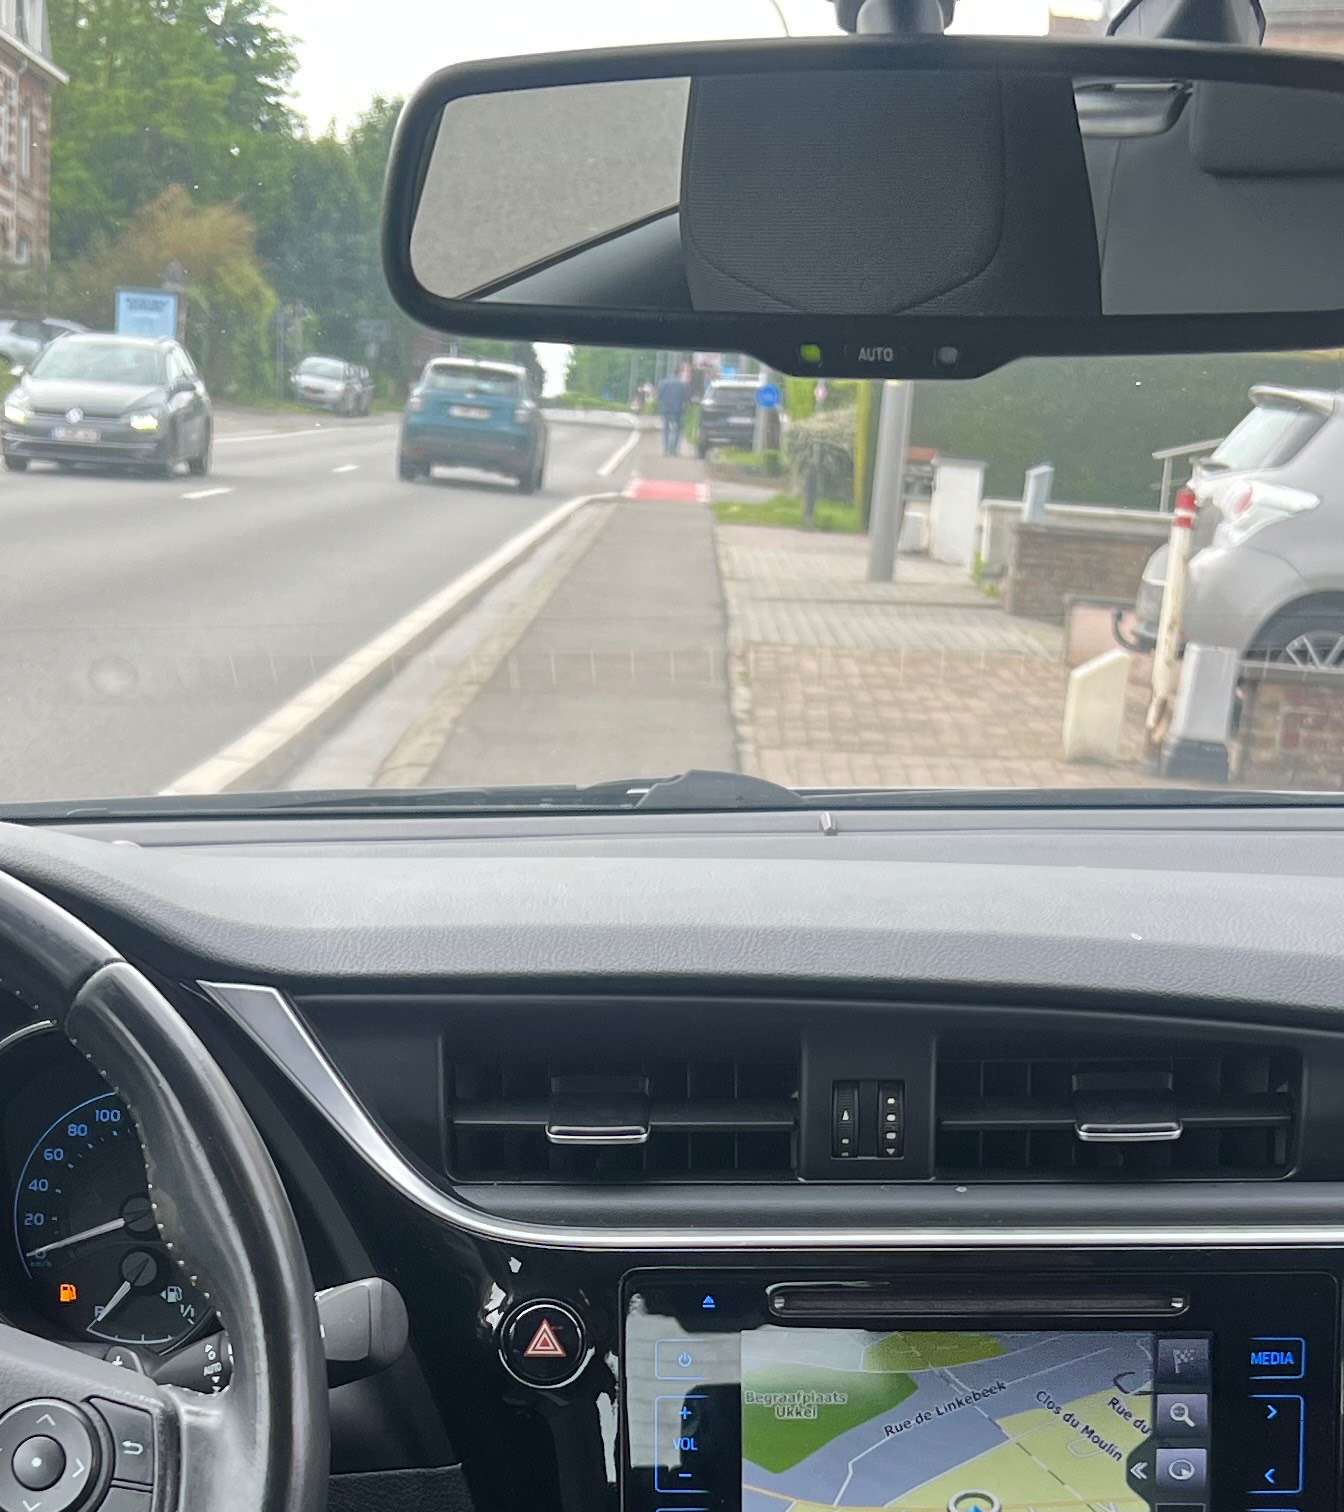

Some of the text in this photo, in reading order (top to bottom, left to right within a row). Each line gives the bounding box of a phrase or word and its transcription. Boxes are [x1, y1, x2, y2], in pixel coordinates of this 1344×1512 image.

[859, 347, 893, 361] AUTO
[95, 1109, 121, 1122] 100
[68, 1123, 88, 1136] 80
[44, 1148, 64, 1161] 60
[28, 1178, 49, 1191] 40
[24, 1213, 45, 1226] 20
[1250, 1351, 1295, 1366] MEDIA
[745, 1391, 848, 1407] Begraafplaats
[884, 1381, 1007, 1438] Rue de Linkebeek
[1108, 1396, 1152, 1435] Rue du
[1036, 1390, 1124, 1461] Clos du Moulin
[672, 1438, 698, 1451] VOL
